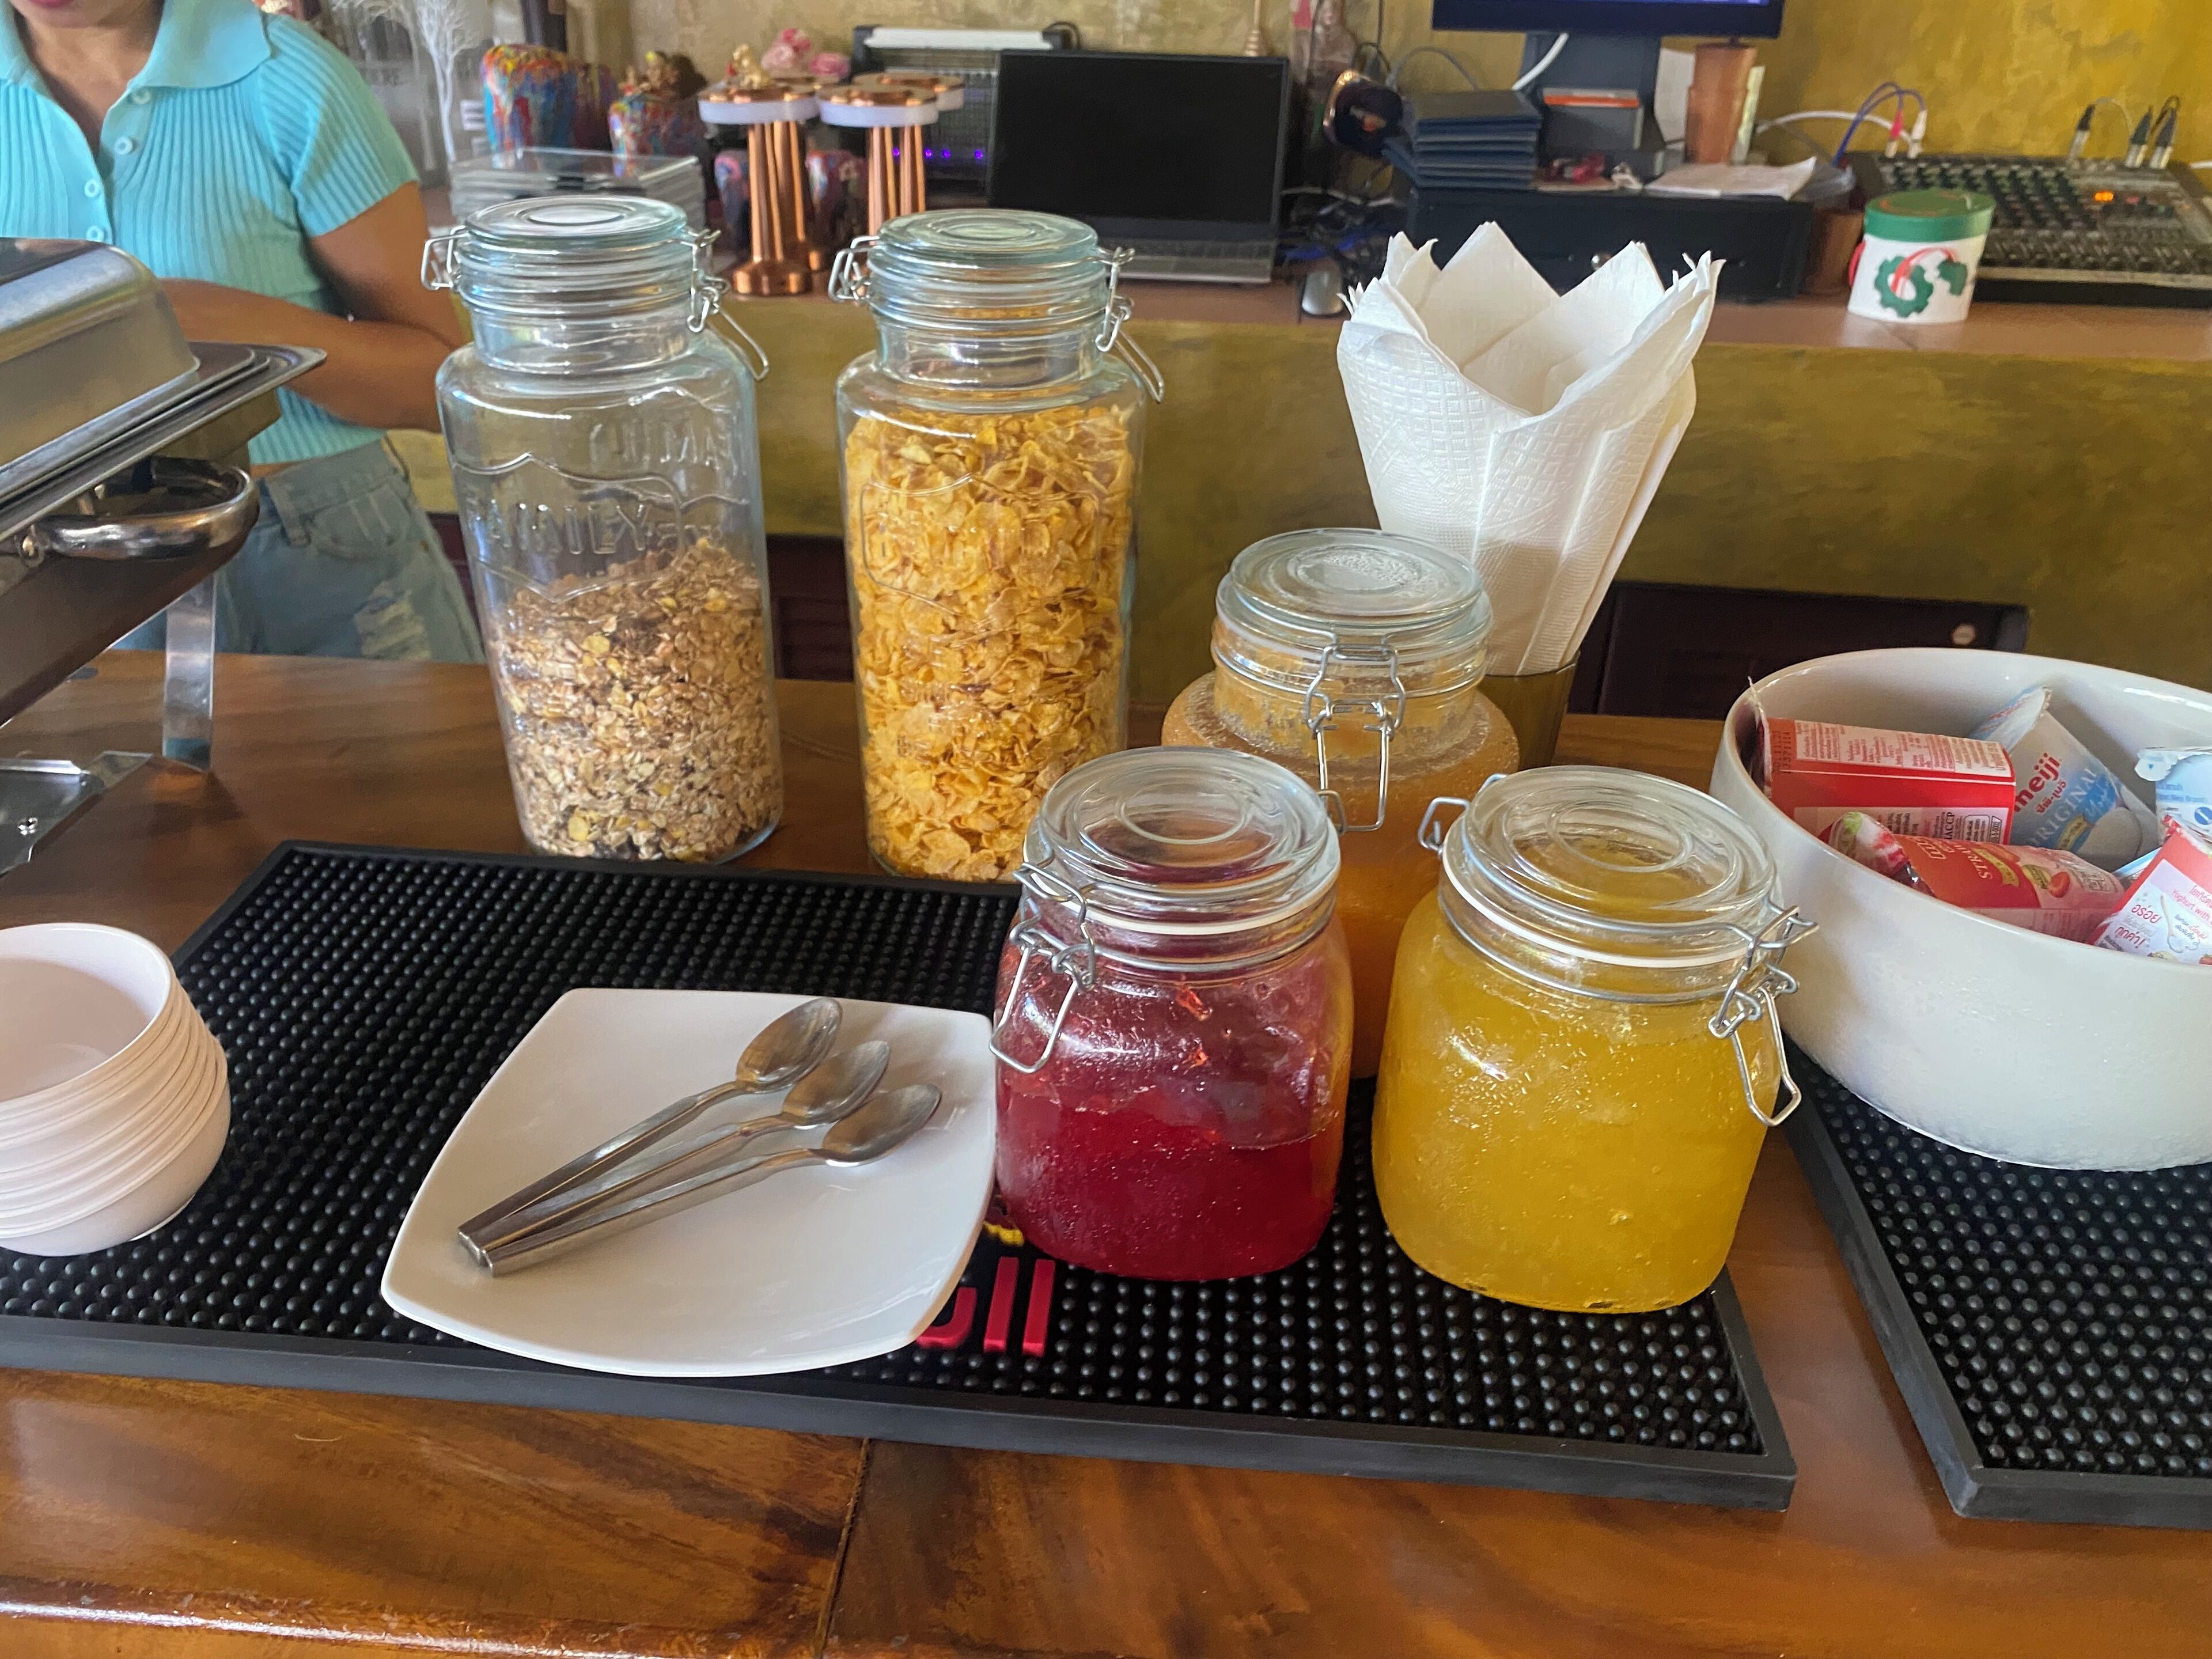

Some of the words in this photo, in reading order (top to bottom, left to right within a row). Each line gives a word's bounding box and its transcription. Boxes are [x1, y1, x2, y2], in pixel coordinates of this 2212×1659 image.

[2014, 752, 2061, 812] meiji
[2131, 904, 2162, 923] อร่อย
[2172, 888, 2196, 910] Yoghurt
[2195, 907, 2210, 920] with
[916, 1256, 1056, 1358] ull
